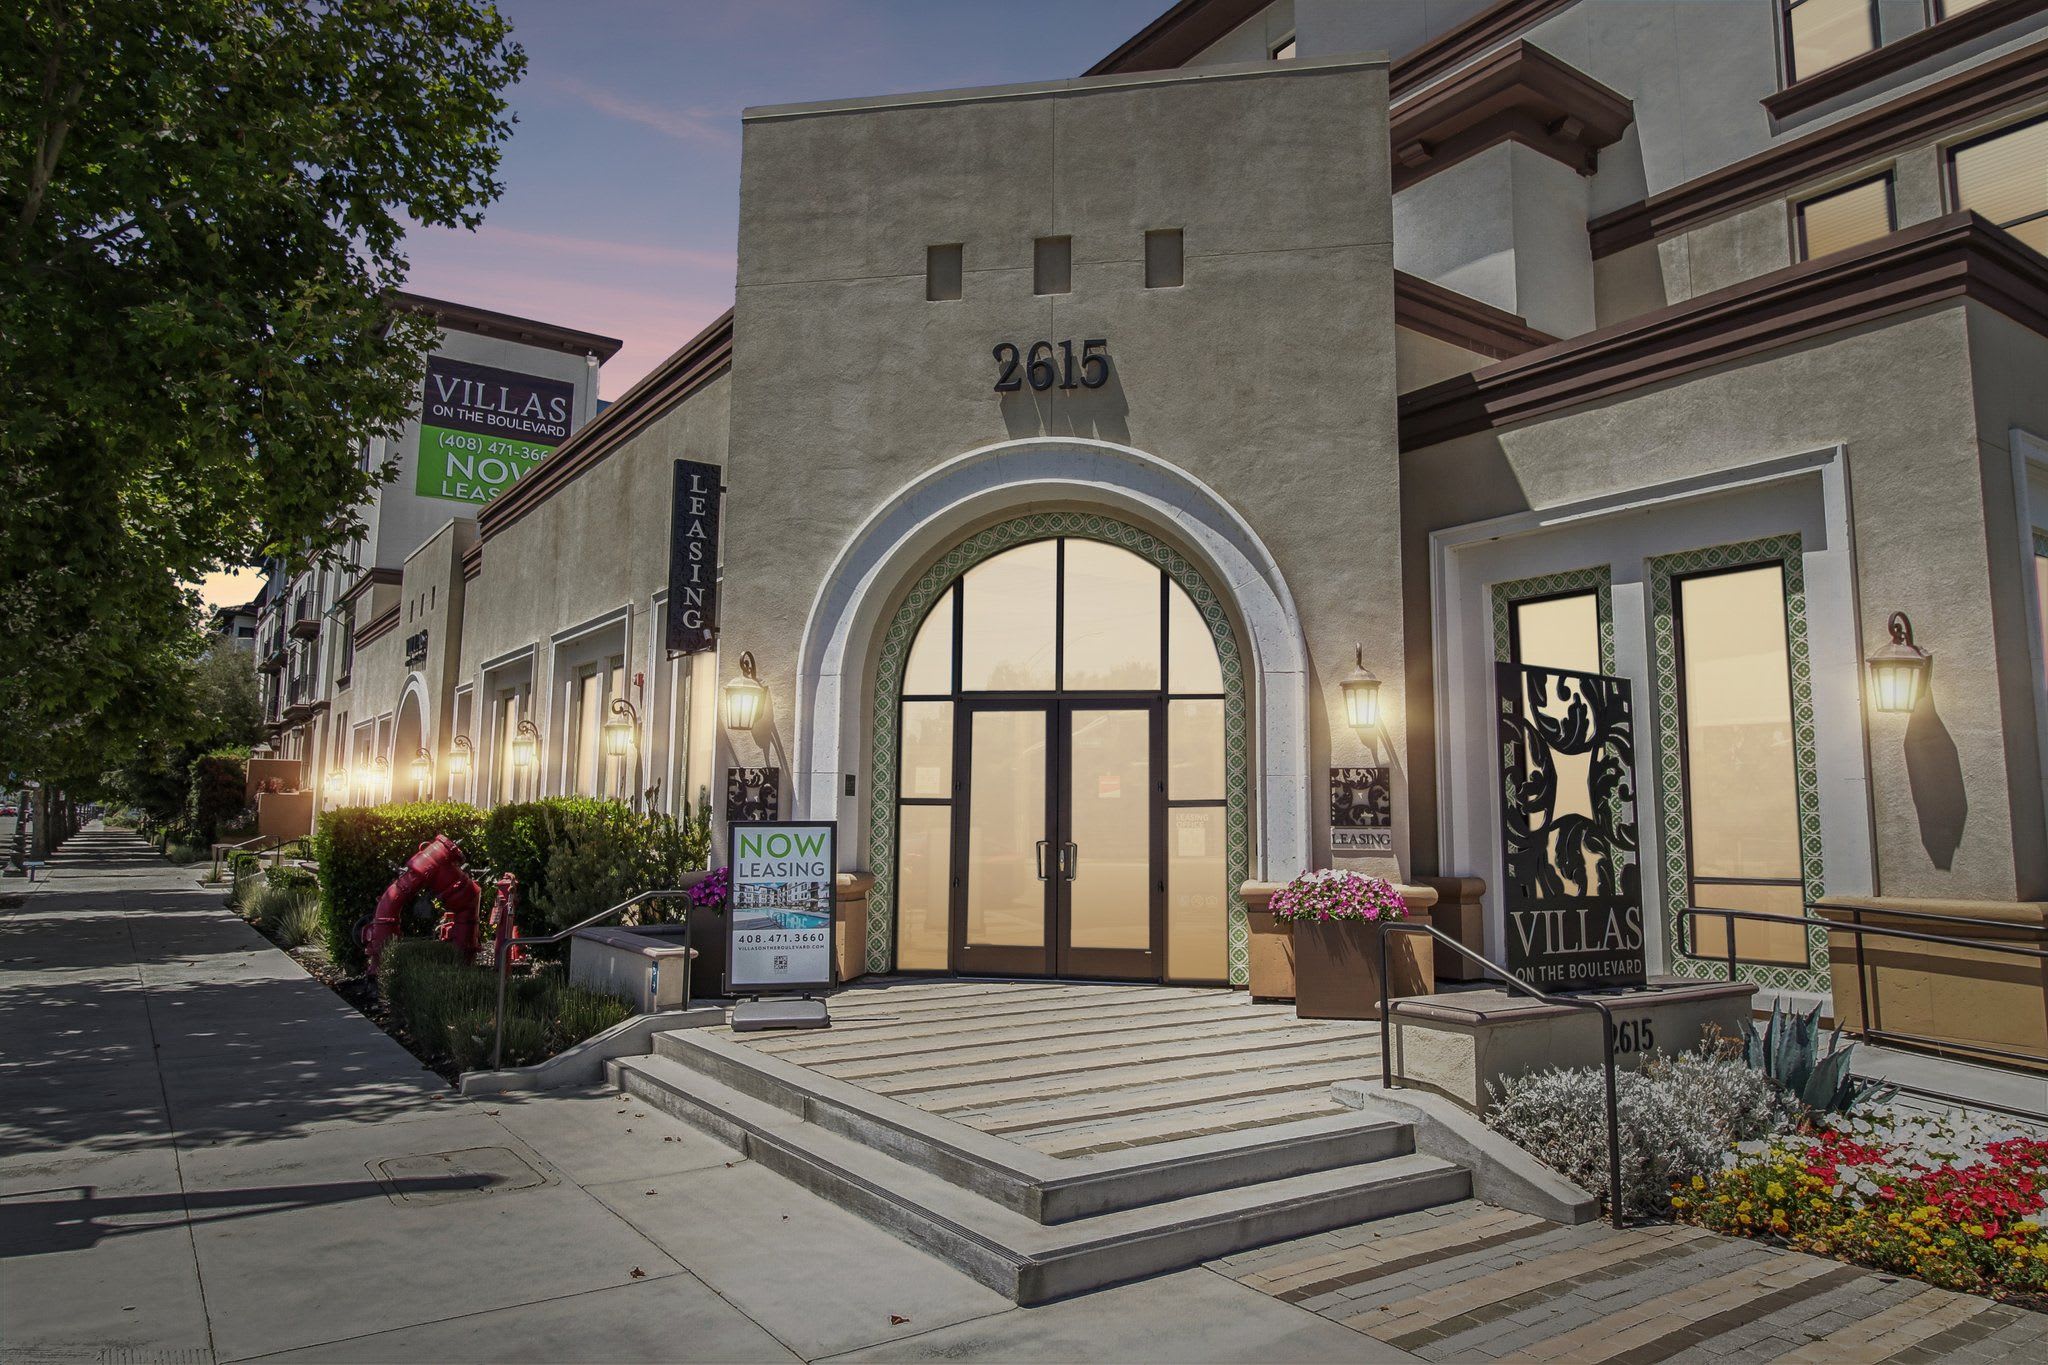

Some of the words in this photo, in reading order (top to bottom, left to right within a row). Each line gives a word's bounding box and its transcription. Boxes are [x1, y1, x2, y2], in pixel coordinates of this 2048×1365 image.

[992, 338, 1109, 392] 2615
[432, 373, 567, 423] VILLAS
[432, 404, 454, 420] ON
[456, 408, 484, 423] THE
[487, 414, 566, 438] BOULEVARD
[438, 431, 483, 454] (408)
[487, 441, 549, 462] 471-366
[442, 480, 501, 502] LEAS
[682, 474, 708, 630] LEASING
[740, 833, 826, 859] NOW
[1332, 833, 1390, 845] LEASING
[739, 861, 825, 878] LEASING
[738, 933, 825, 943] 408.471.3660
[1510, 906, 1643, 957] VILLAS
[1515, 966, 1535, 983] ON
[1538, 964, 1565, 982] THE
[1569, 959, 1642, 979] BOULEVARD
